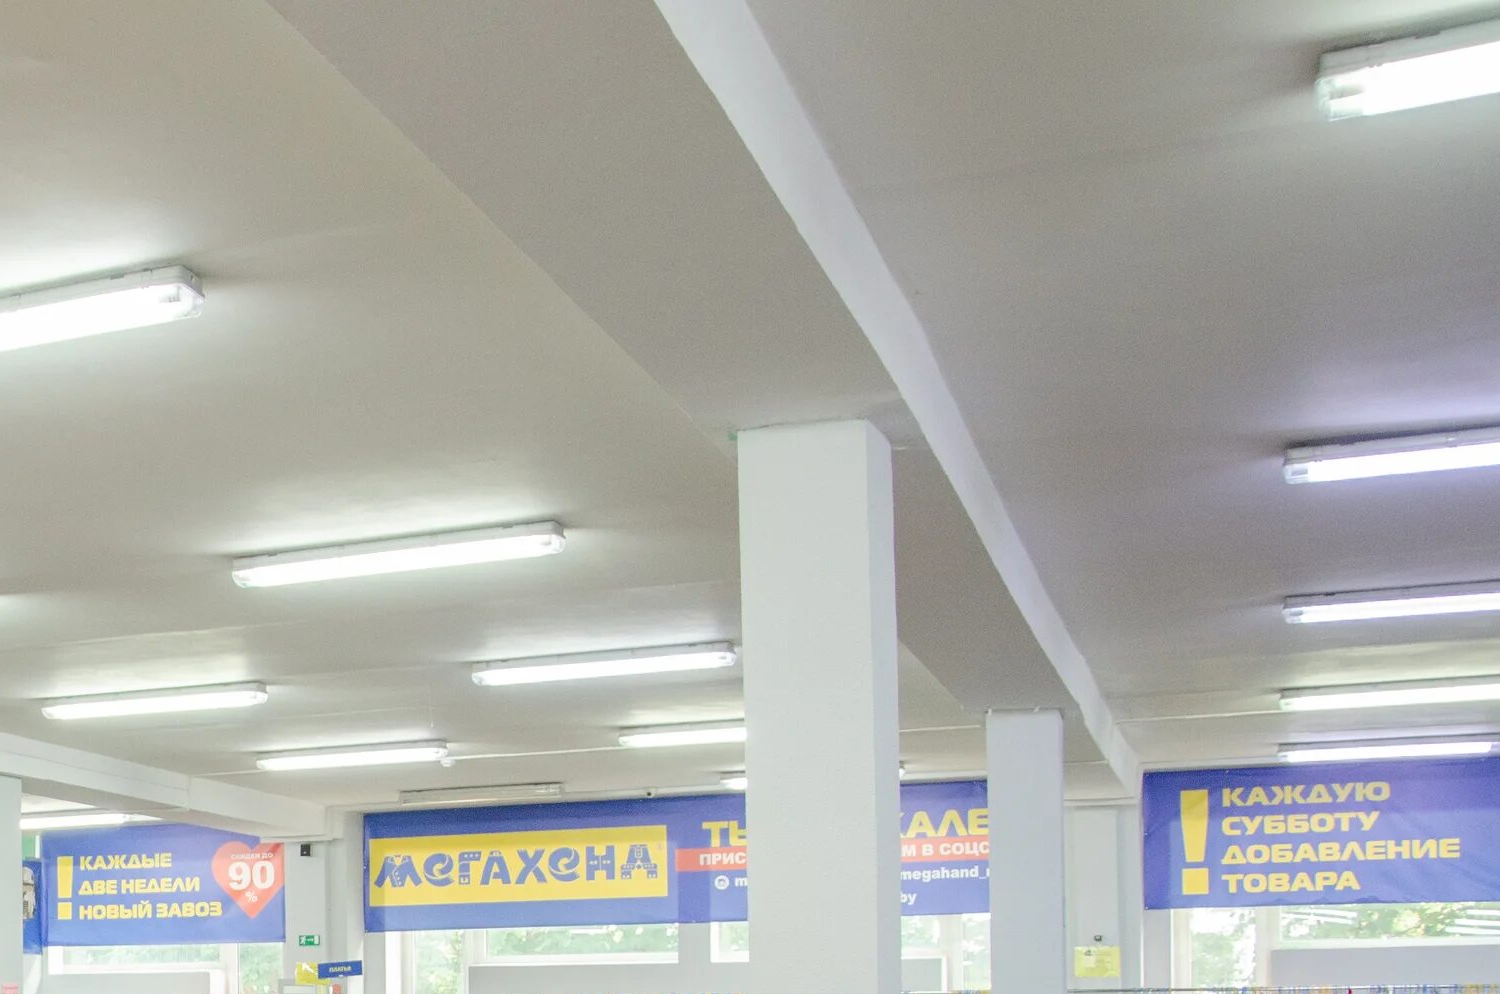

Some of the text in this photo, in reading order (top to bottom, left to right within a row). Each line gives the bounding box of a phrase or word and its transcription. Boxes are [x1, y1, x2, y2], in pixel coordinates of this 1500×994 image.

[1221, 781, 1391, 807] КАЖДУЮ
[1221, 811, 1380, 836] СУББОТУ
[922, 844, 934, 856] В
[1221, 838, 1460, 865] ДОБАВЛЕНИЕ
[80, 853, 172, 871] КАЖДЫЕ
[78, 876, 200, 896] ДВЕ НЕДЕЛИ
[228, 861, 275, 890] 90
[1221, 871, 1361, 894] ТОВАРА
[79, 900, 222, 920] НОВЫЙ ЗАВОЗ
